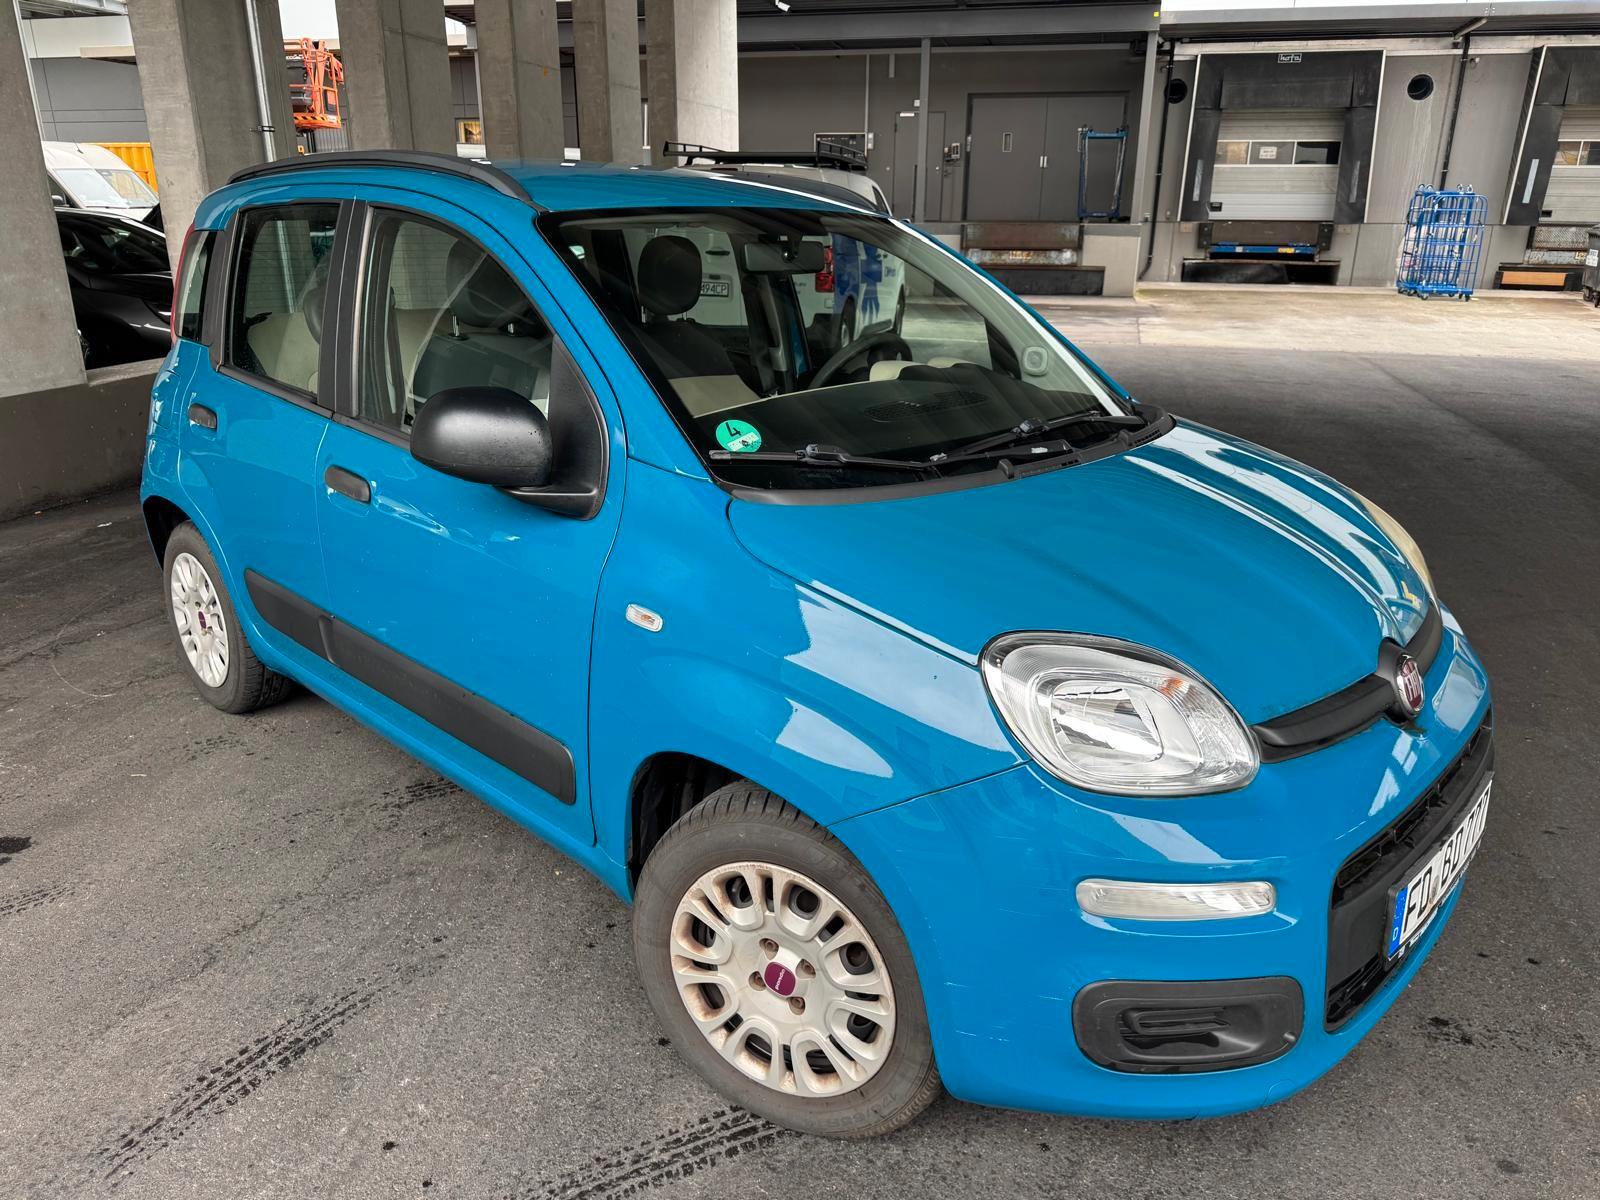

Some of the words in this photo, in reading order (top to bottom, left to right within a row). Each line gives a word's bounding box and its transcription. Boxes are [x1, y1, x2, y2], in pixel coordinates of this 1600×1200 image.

[725, 421, 742, 437] 4
[1403, 865, 1433, 934] FD
[1441, 825, 1464, 889] BD
[1463, 788, 1489, 857] 777
